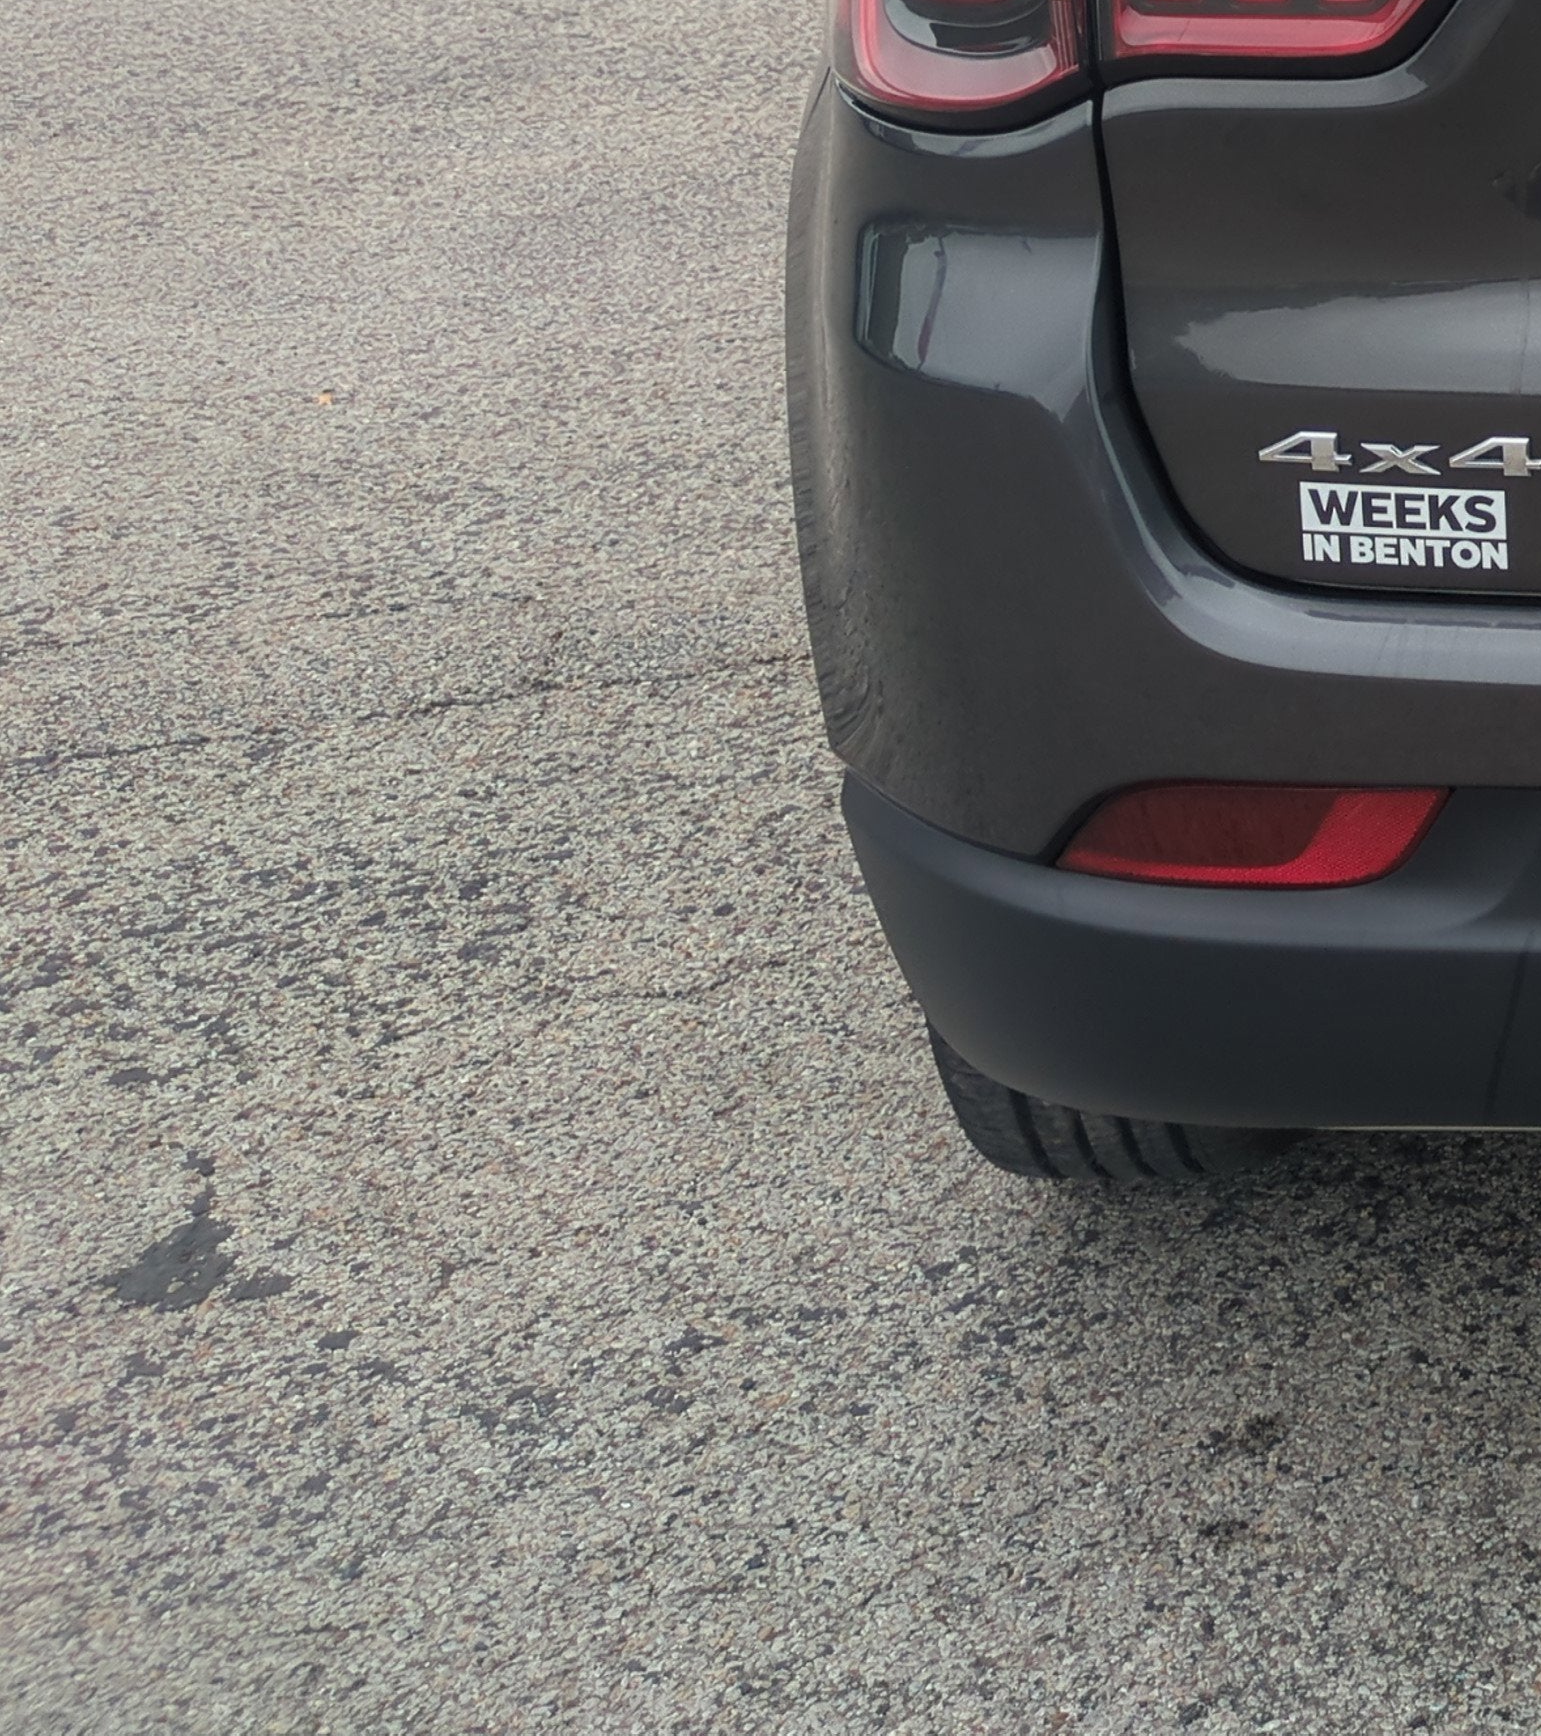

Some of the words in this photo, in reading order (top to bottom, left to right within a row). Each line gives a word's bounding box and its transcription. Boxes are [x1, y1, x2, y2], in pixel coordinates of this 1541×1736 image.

[1307, 487, 1498, 534] WEEKS
[1302, 532, 1341, 563] IN
[1350, 534, 1509, 570] BENTON
